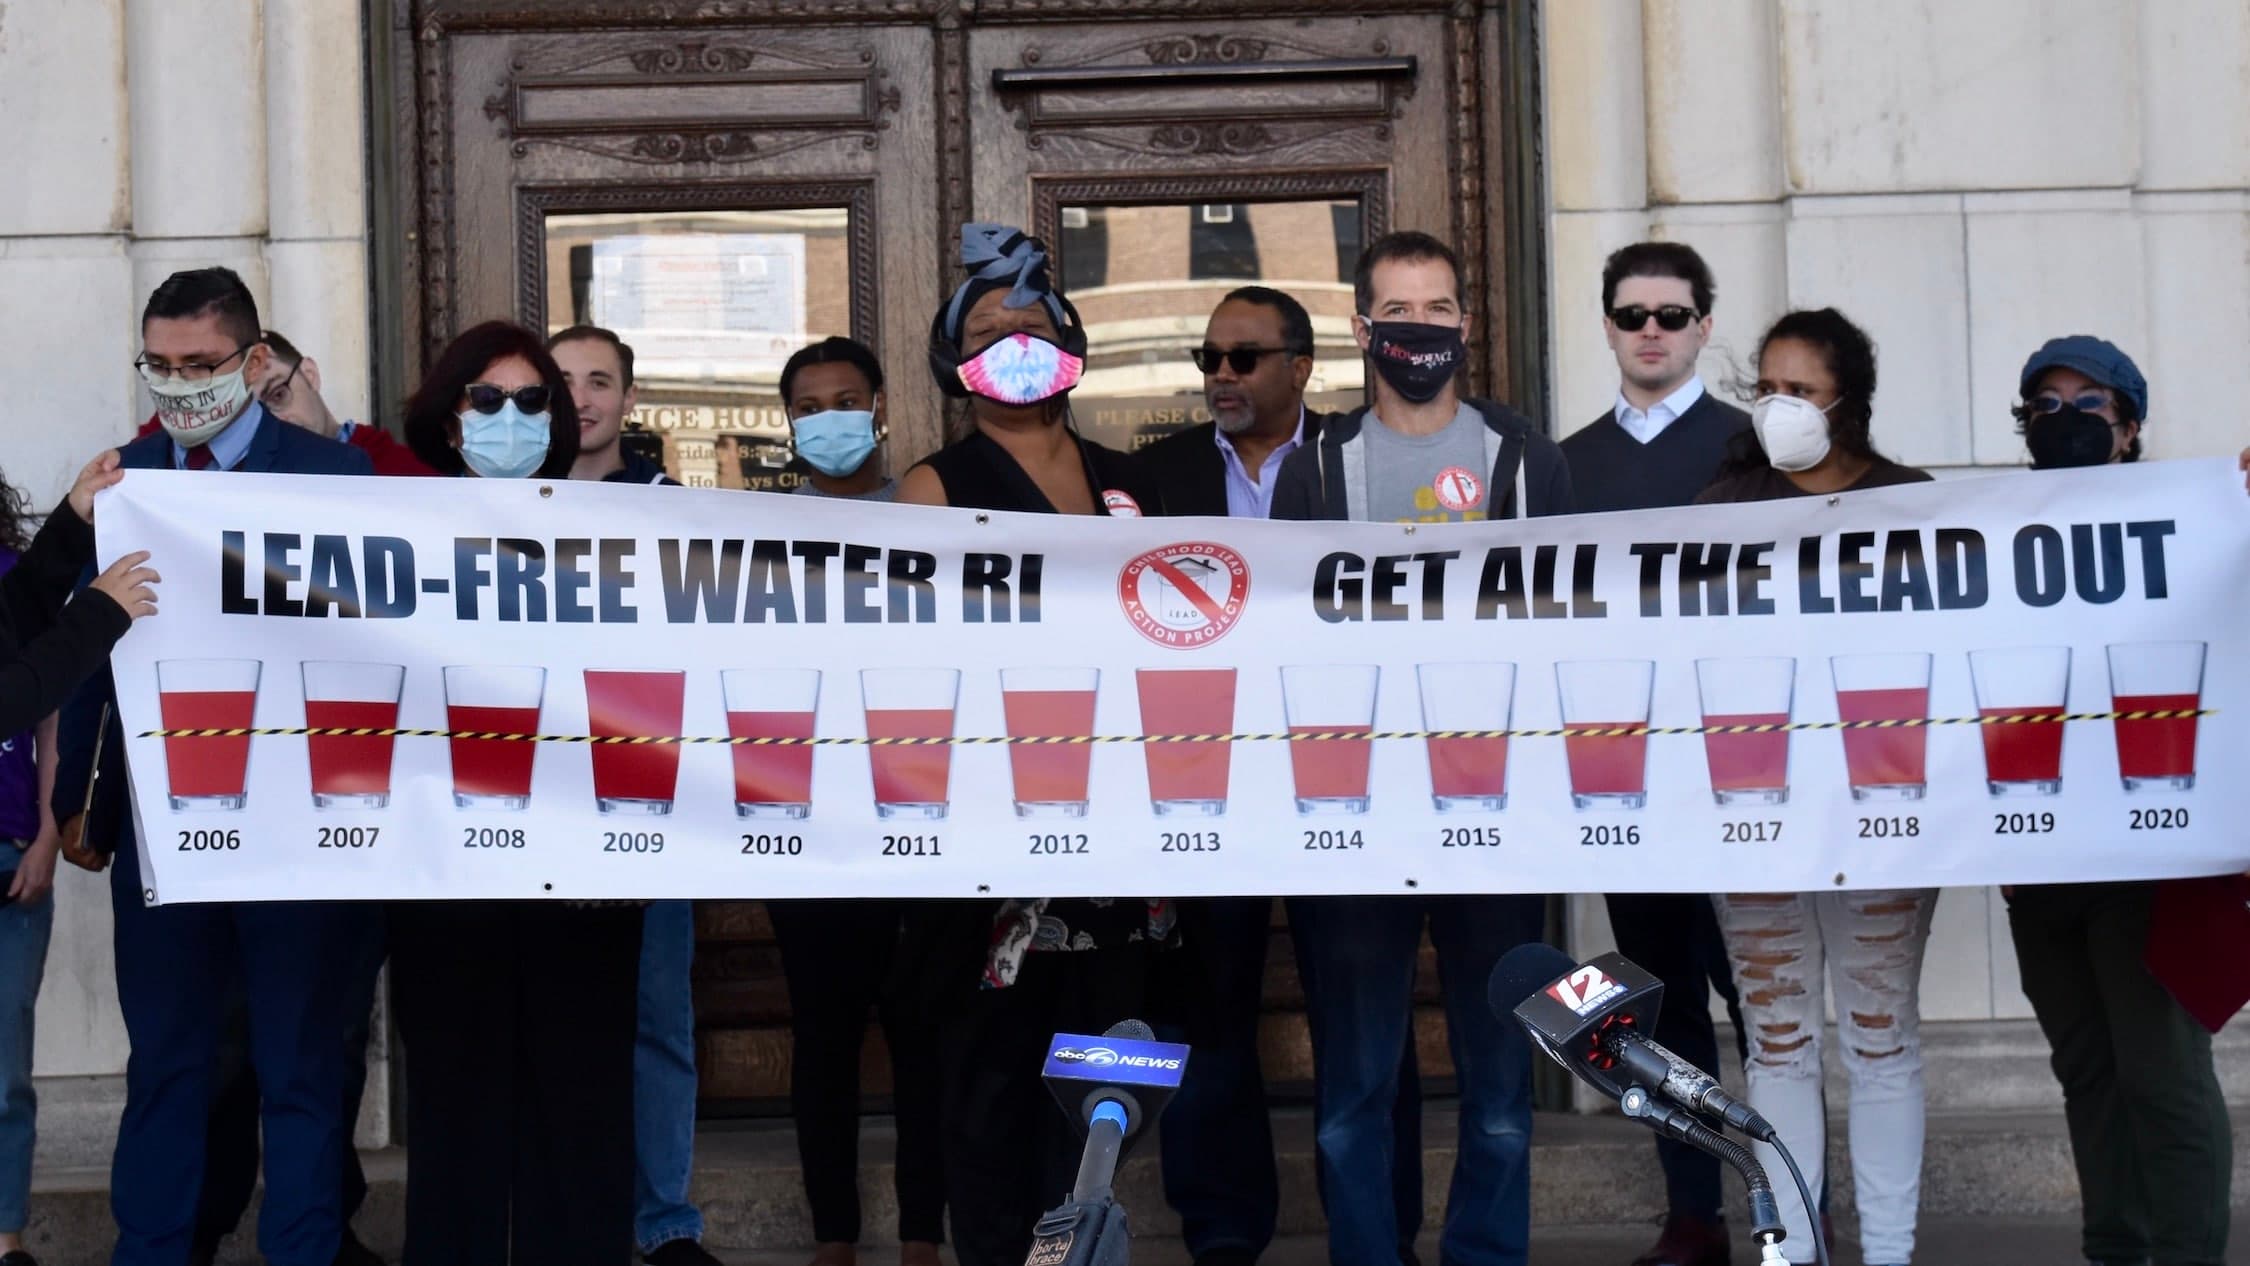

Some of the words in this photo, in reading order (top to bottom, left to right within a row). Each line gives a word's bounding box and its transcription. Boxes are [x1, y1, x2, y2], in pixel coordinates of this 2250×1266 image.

[197, 389, 216, 407] IN
[209, 398, 234, 421] OUT
[1095, 407, 1185, 426] PLEASE
[222, 530, 638, 623] LEAD-FREE
[658, 538, 937, 624] WATER
[963, 552, 1045, 623] RI
[1128, 545, 1215, 575] CHILDHOOD
[1217, 550, 1244, 577] LEAD
[1312, 550, 1461, 624] GET
[1475, 543, 1608, 620] ALL
[1629, 540, 1777, 618] THE
[1798, 528, 1989, 614] LEAD
[2012, 519, 2177, 608] OUT
[1127, 600, 1177, 643] ACTION
[1184, 596, 1242, 644] PROJECT
[1169, 609, 1199, 619] LEAD
[178, 830, 241, 852] 2006
[317, 826, 380, 849] 2007
[463, 827, 527, 849] 2008
[602, 831, 665, 853] 2009
[740, 833, 803, 856] 2010
[881, 834, 942, 857] 2011
[1028, 833, 1090, 855] 2012
[1160, 831, 1221, 852] 2013
[1303, 829, 1365, 850] 2014
[1441, 826, 1502, 848] 2015
[1579, 824, 1641, 846] 2016
[1722, 820, 1783, 843] 2017
[1858, 816, 1920, 838] 2018
[1994, 812, 2055, 834] 2019
[2128, 808, 2189, 830] 2020
[1555, 965, 1614, 1012] 12
[1053, 1050, 1086, 1061] abc
[1085, 1049, 1115, 1066] 6
[1119, 1056, 1180, 1070] NEWS
